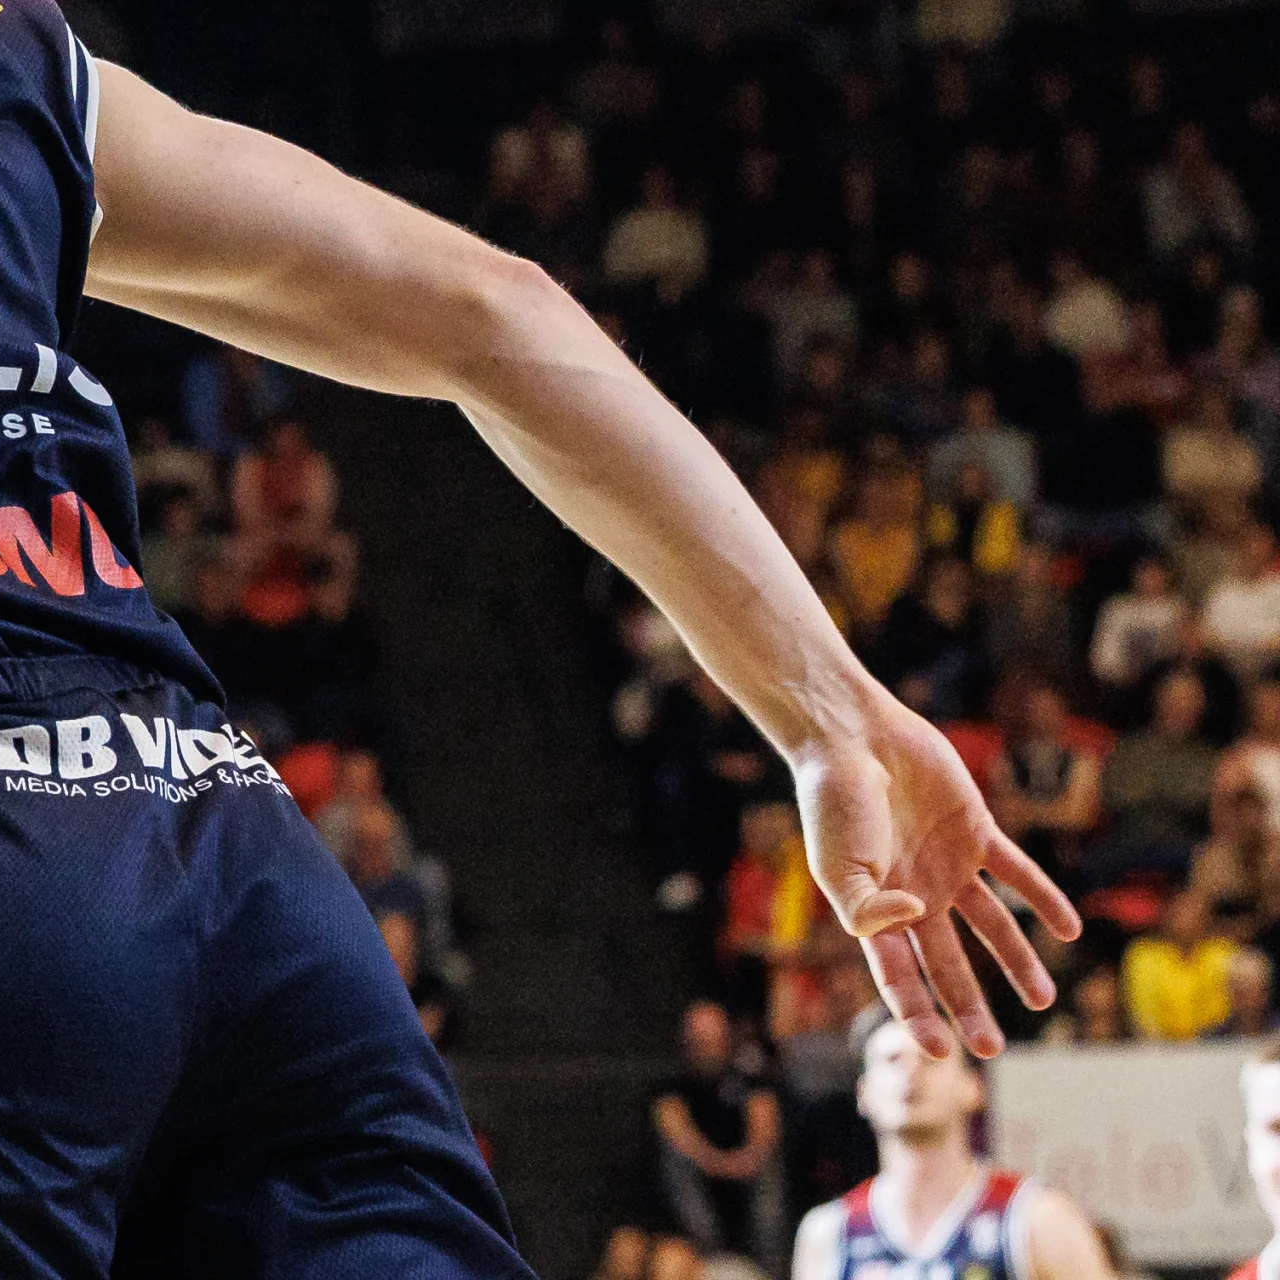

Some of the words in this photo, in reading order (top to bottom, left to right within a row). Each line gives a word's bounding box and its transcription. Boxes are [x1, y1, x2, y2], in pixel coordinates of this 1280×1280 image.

[119, 713, 281, 780] VIDE
[5, 776, 88, 798] MEDIA
[95, 772, 213, 804] SOLUTIONS
[216, 767, 235, 785] &
